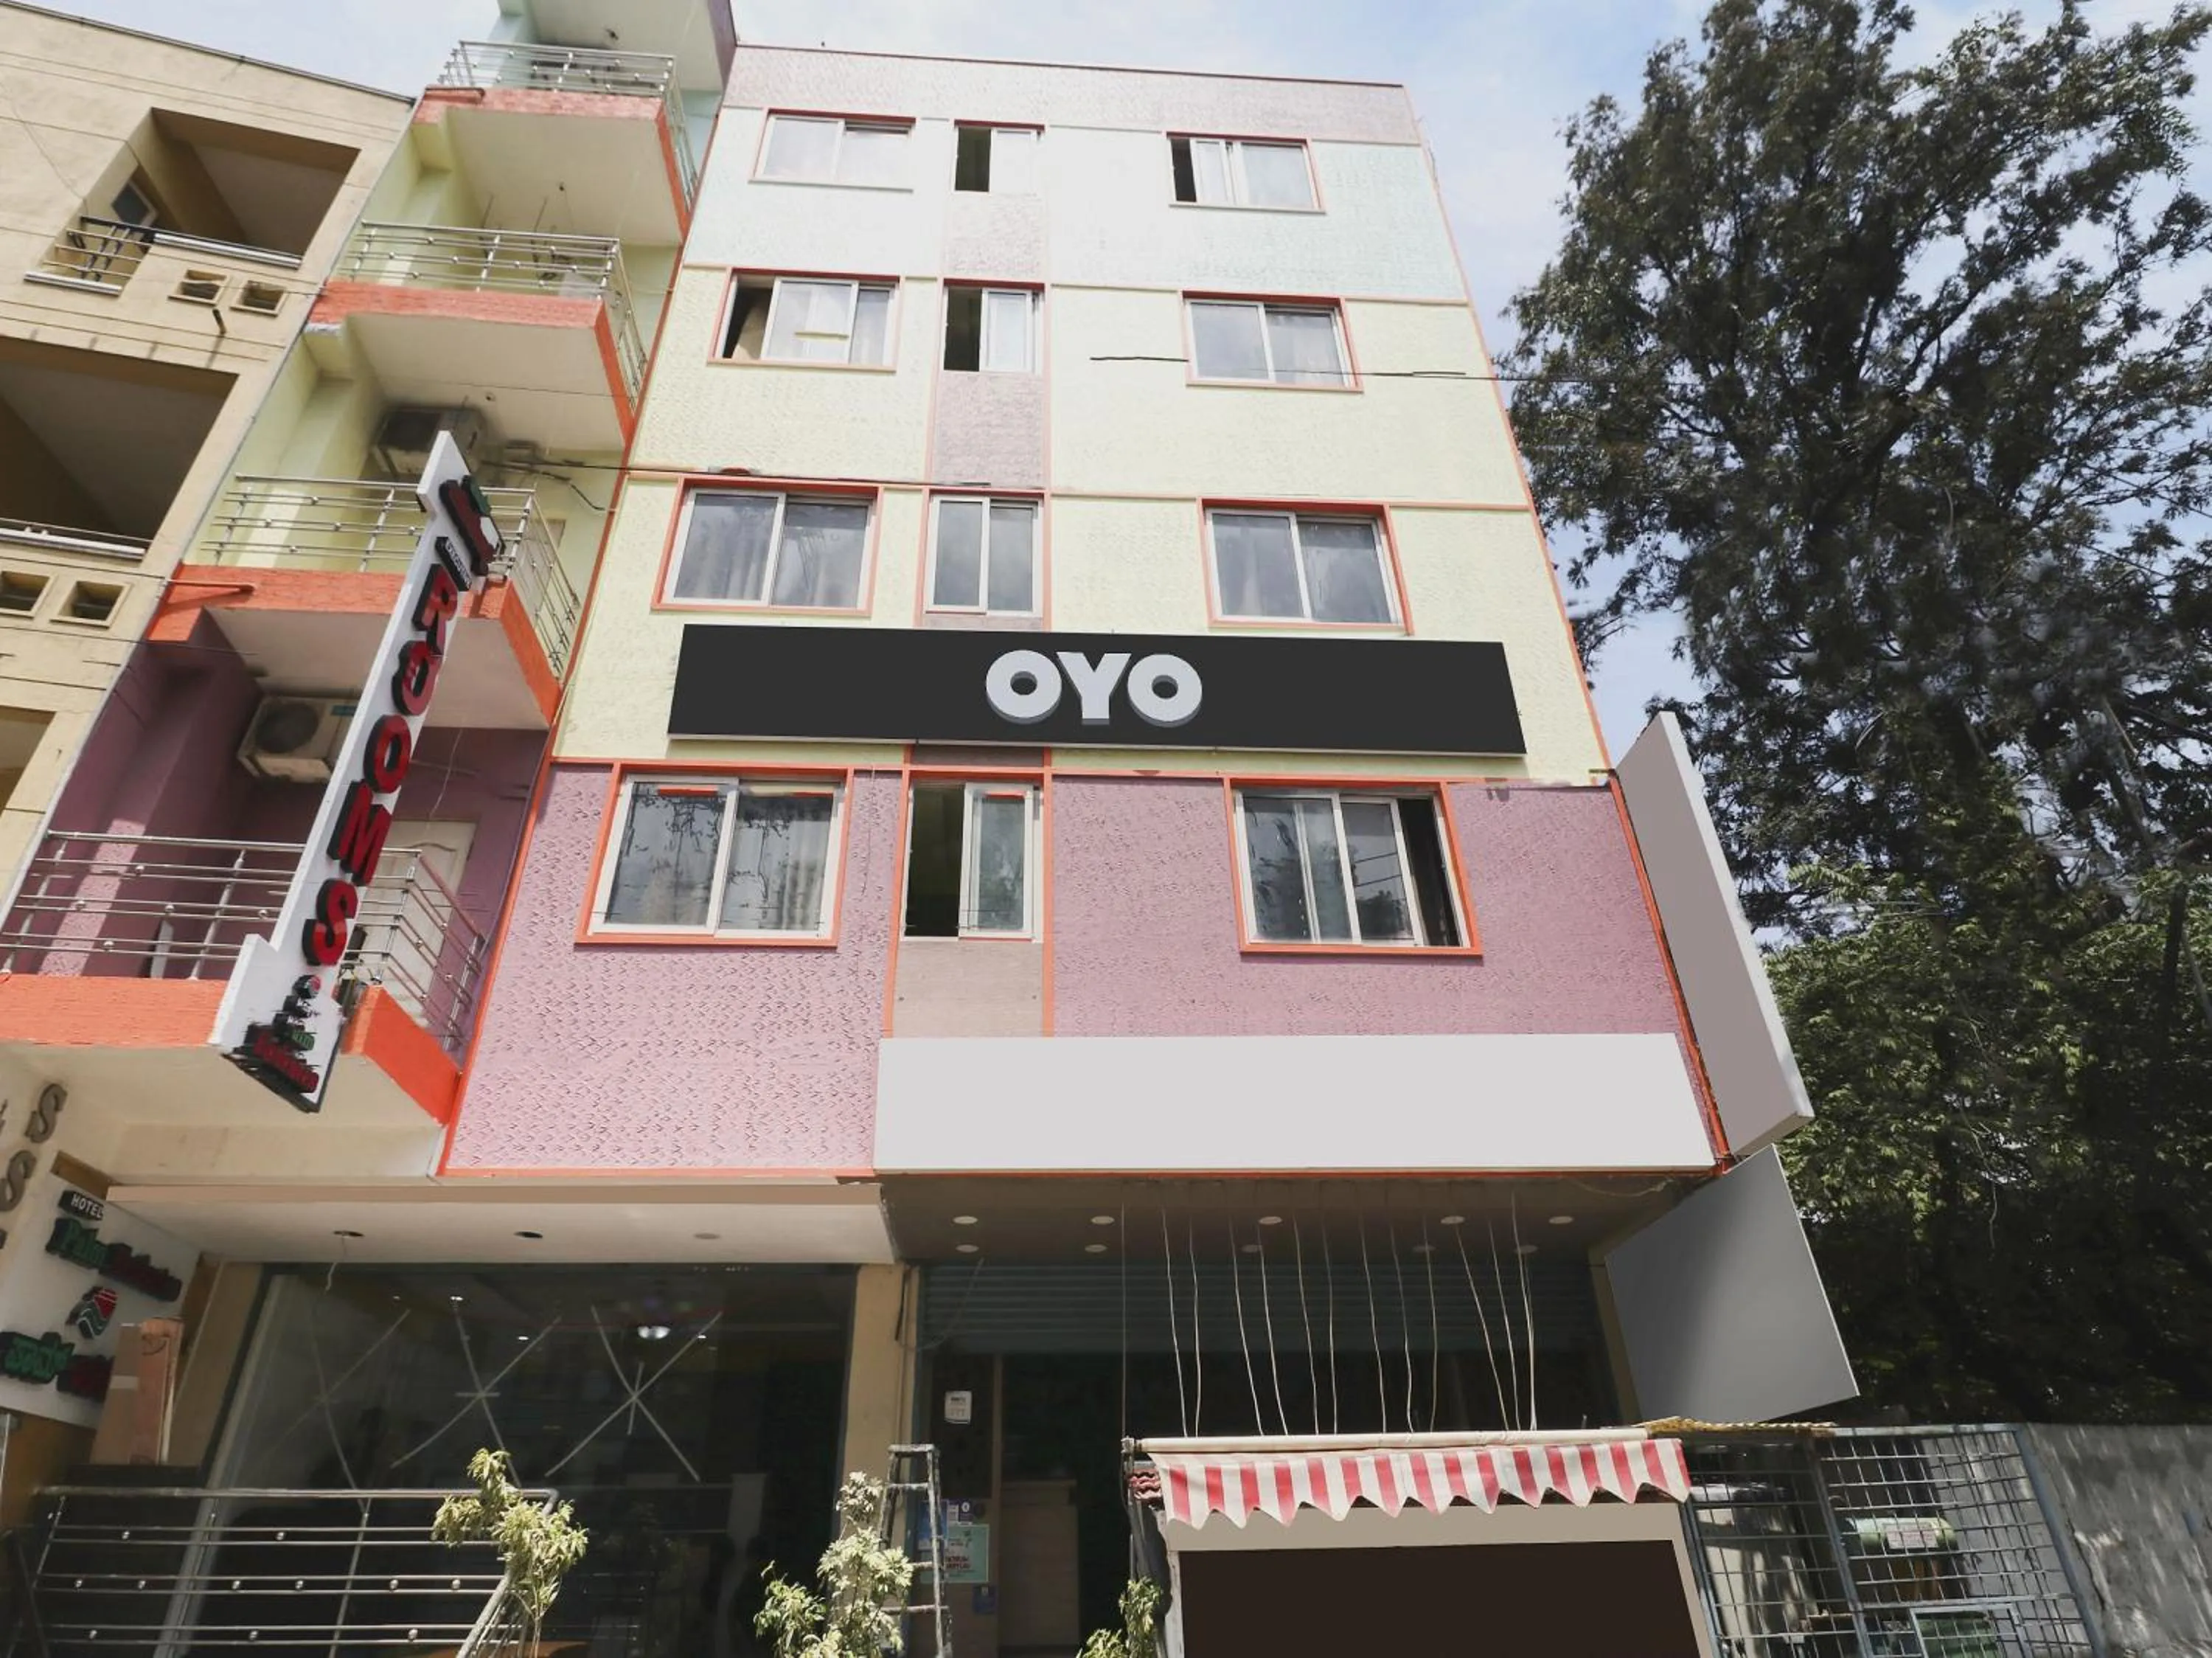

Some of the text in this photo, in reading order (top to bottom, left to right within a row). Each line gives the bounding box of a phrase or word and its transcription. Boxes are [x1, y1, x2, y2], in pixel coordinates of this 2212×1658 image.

[986, 650, 1203, 728] OYO
[303, 563, 457, 967] ROOMS
[71, 1192, 105, 1220] HOTEL
